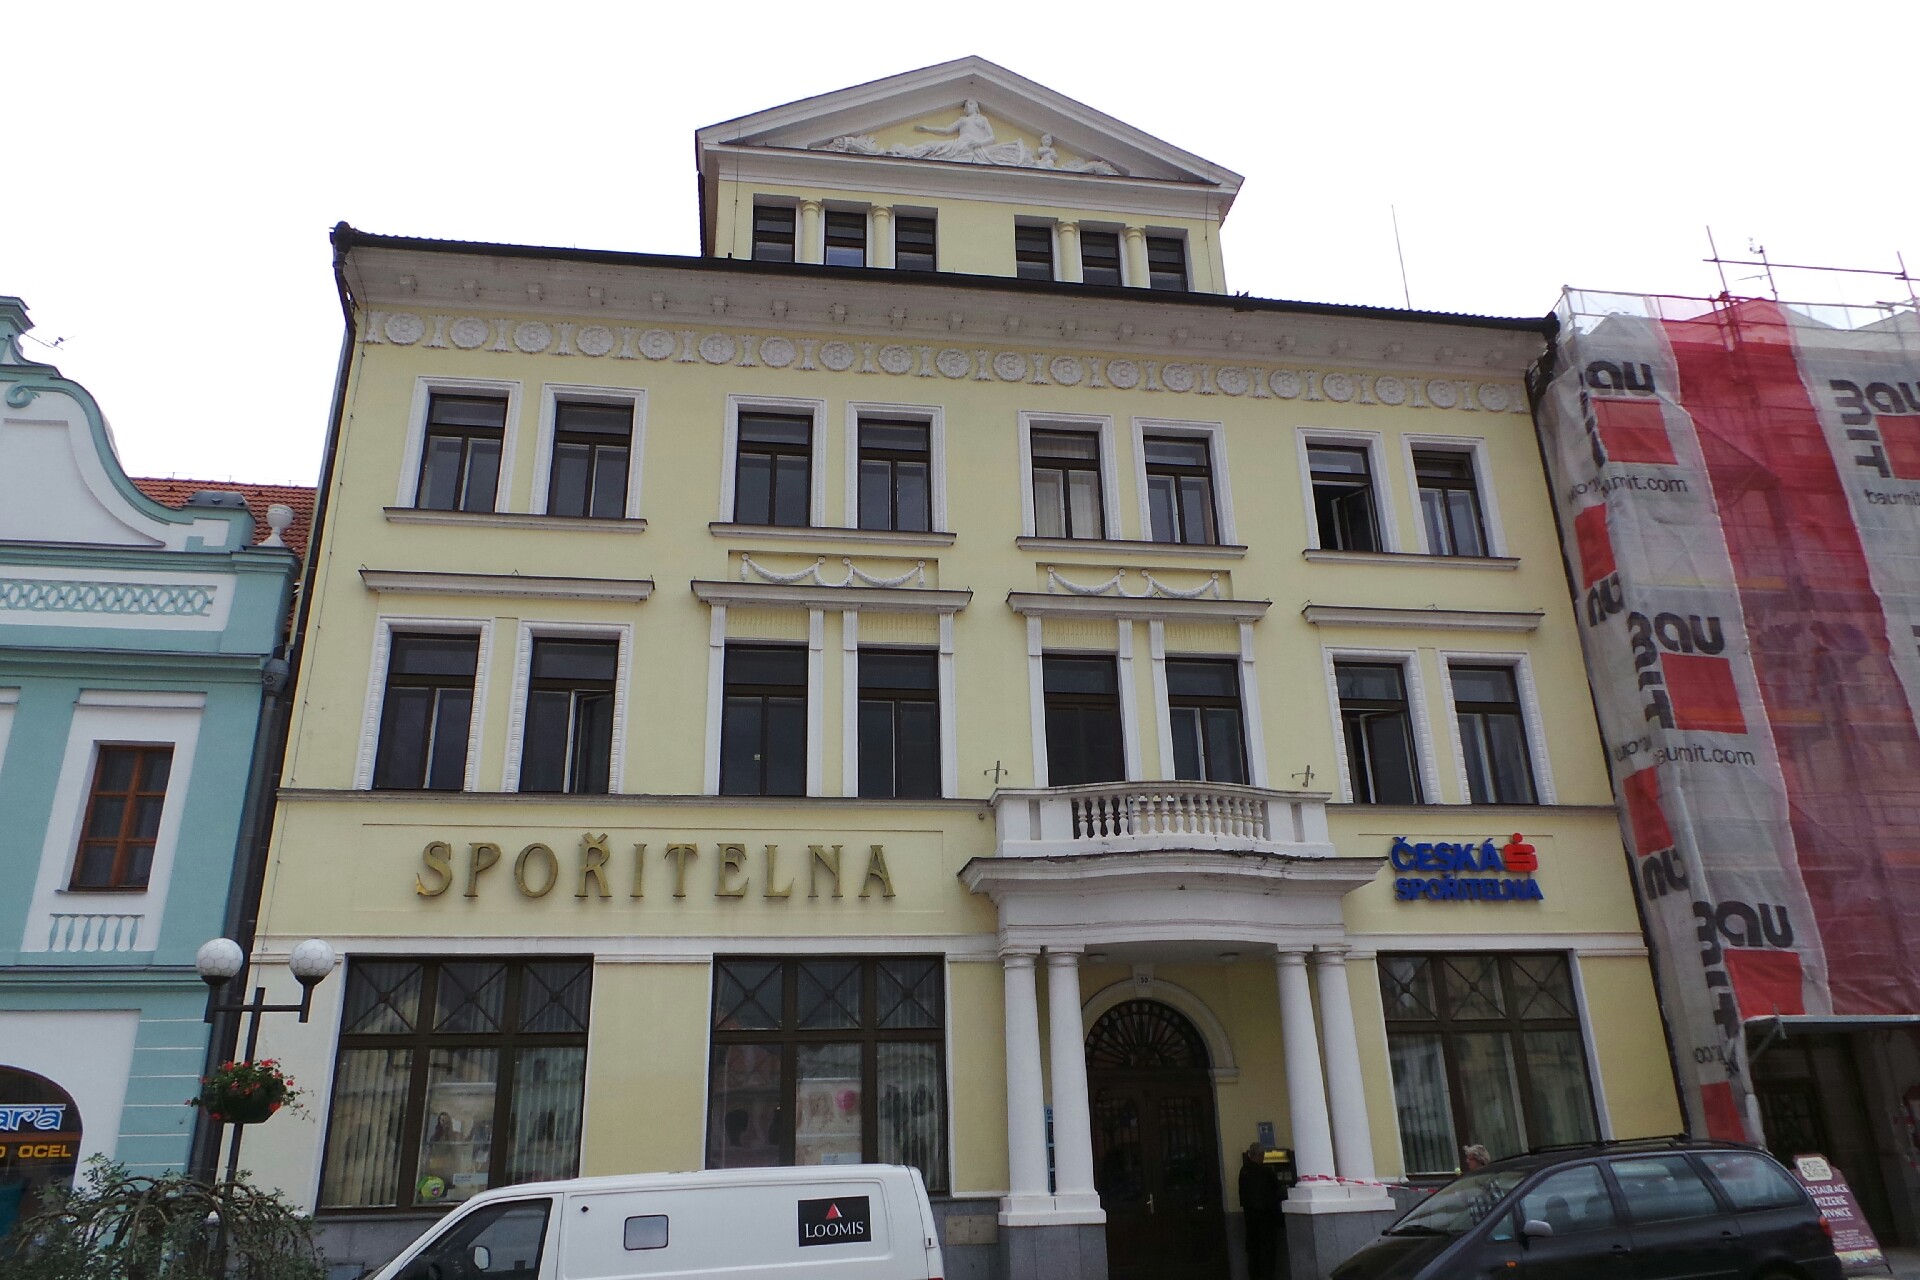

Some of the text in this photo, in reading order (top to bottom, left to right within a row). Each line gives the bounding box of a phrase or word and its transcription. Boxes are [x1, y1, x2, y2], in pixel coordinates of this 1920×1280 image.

[416, 832, 897, 898] SPOŘITELNA
[1390, 836, 1505, 873] ČESKÁ
[1395, 873, 1545, 900] SPOŘITELNA
[18, 1145, 72, 1158] OCEL
[804, 1221, 864, 1239] LOOMIS
